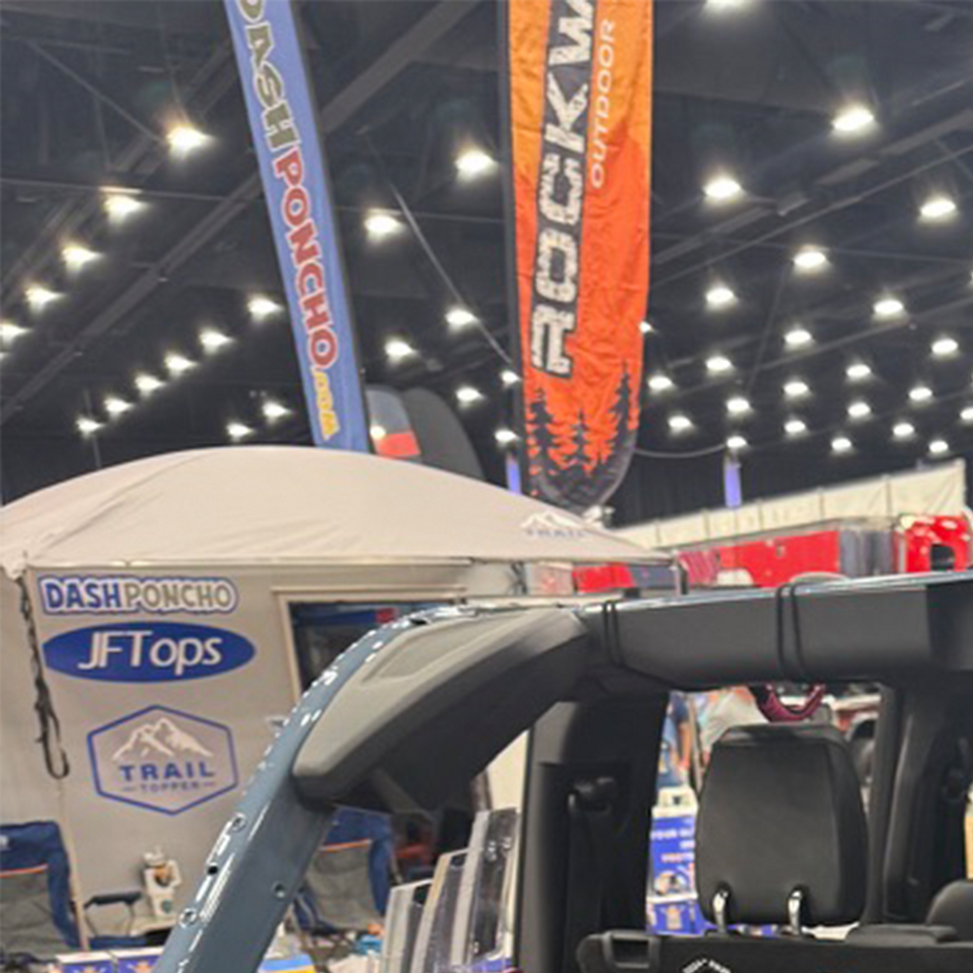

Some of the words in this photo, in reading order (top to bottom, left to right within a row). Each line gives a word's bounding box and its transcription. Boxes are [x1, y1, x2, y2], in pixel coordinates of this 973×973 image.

[591, 19, 615, 189] OUTDOOR
[77, 630, 222, 676] JFTops
[118, 761, 214, 781] TRAIL
